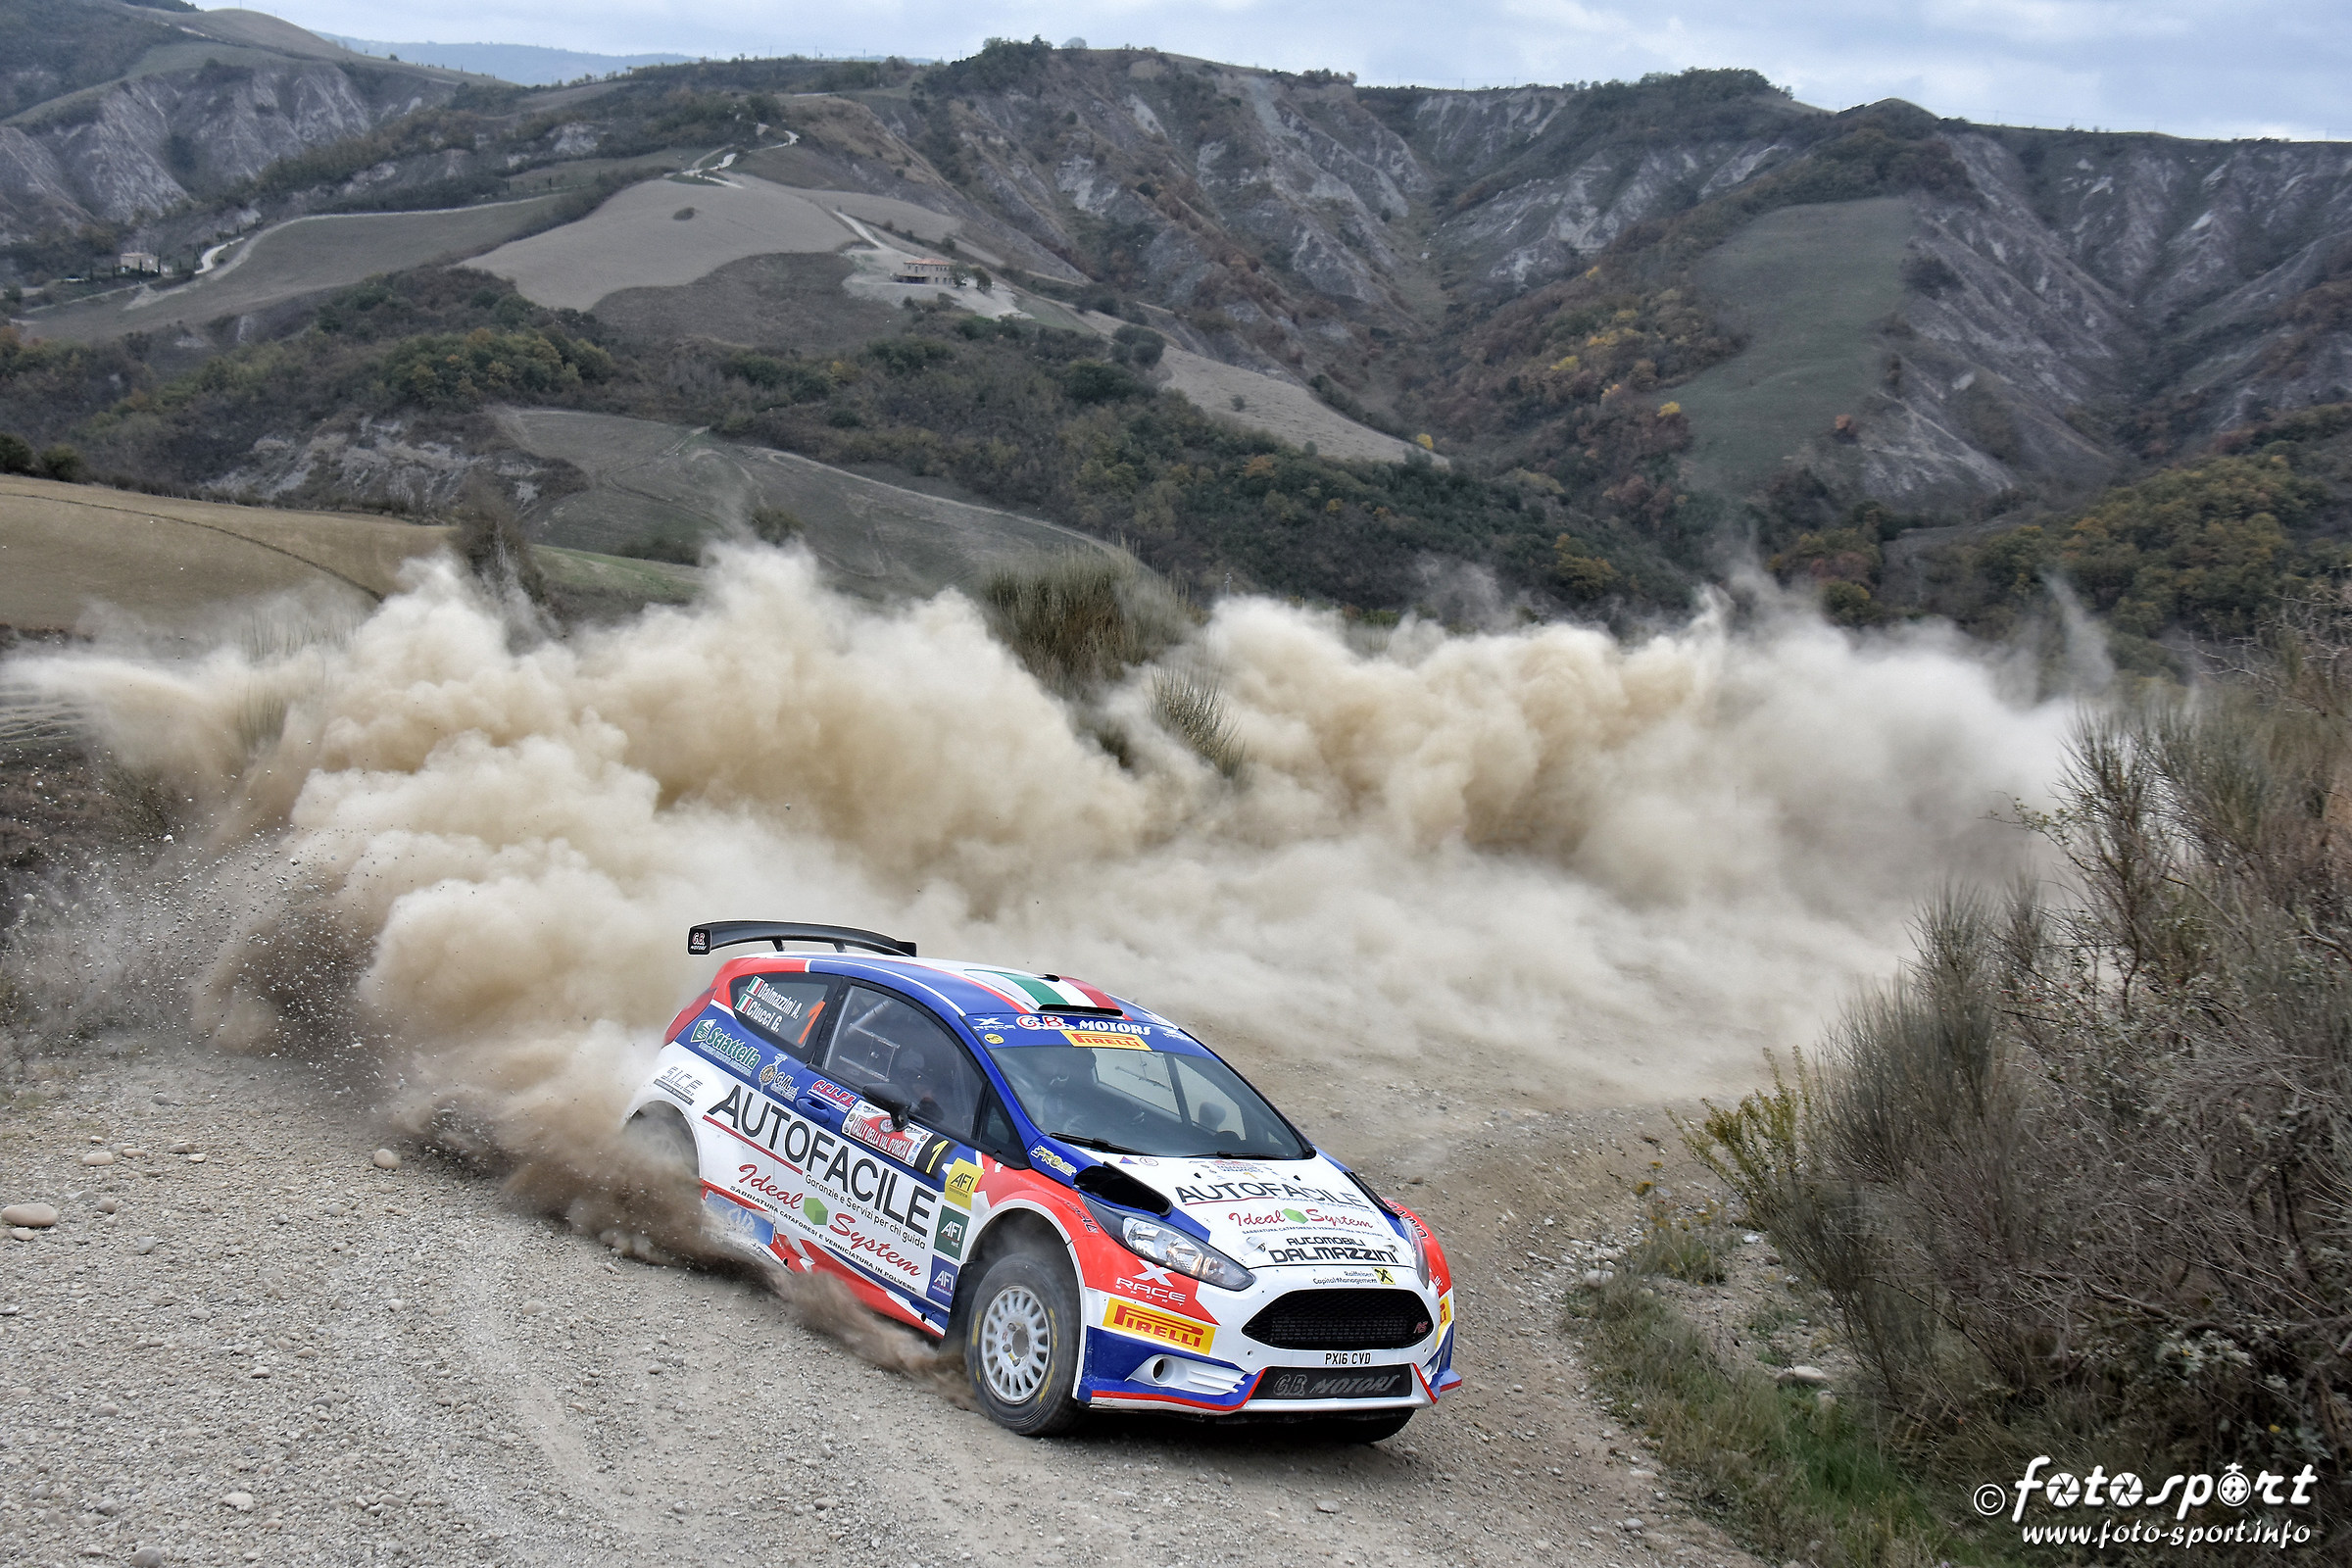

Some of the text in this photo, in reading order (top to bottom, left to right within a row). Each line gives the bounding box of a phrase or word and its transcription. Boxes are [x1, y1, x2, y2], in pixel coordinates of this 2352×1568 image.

[758, 982, 803, 1019] Dalmazzini A.
[746, 1001, 783, 1032] Ciucci G.
[798, 1001, 825, 1045] 1
[1079, 1019, 1151, 1035] MOTORS
[708, 1027, 760, 1069] Sciattella
[1070, 1033, 1141, 1047] PIRELLI
[864, 1127, 881, 1146] DELLA
[707, 1084, 937, 1238] AUTOFACILE
[925, 1140, 949, 1174] 1
[739, 1163, 804, 1210] Ideal
[950, 1172, 974, 1192] AFI
[1175, 1182, 1370, 1209] AUTOFACILE
[805, 1173, 925, 1250] Garanzie e Servizi per chi guida
[1229, 1210, 1286, 1226] Ideal
[1305, 1208, 1373, 1228] System
[941, 1220, 963, 1242] AFI
[1286, 1237, 1365, 1247] AUTOMOBILI
[780, 1210, 818, 1236] CATAFORESI
[825, 1237, 873, 1269] VERNICIATURA
[873, 1265, 883, 1274] IN
[884, 1271, 917, 1293] POLVERE
[829, 1213, 921, 1276] System
[1268, 1248, 1398, 1263] DALMAZZINI
[934, 1270, 954, 1291] AFI
[1115, 1277, 1187, 1302] RACE
[1115, 1285, 1184, 1306] SPORT
[1113, 1304, 1204, 1348] PIRELLI
[1325, 1352, 1371, 1364] PX16 CVD
[1309, 1374, 1400, 1394] MOTORS
